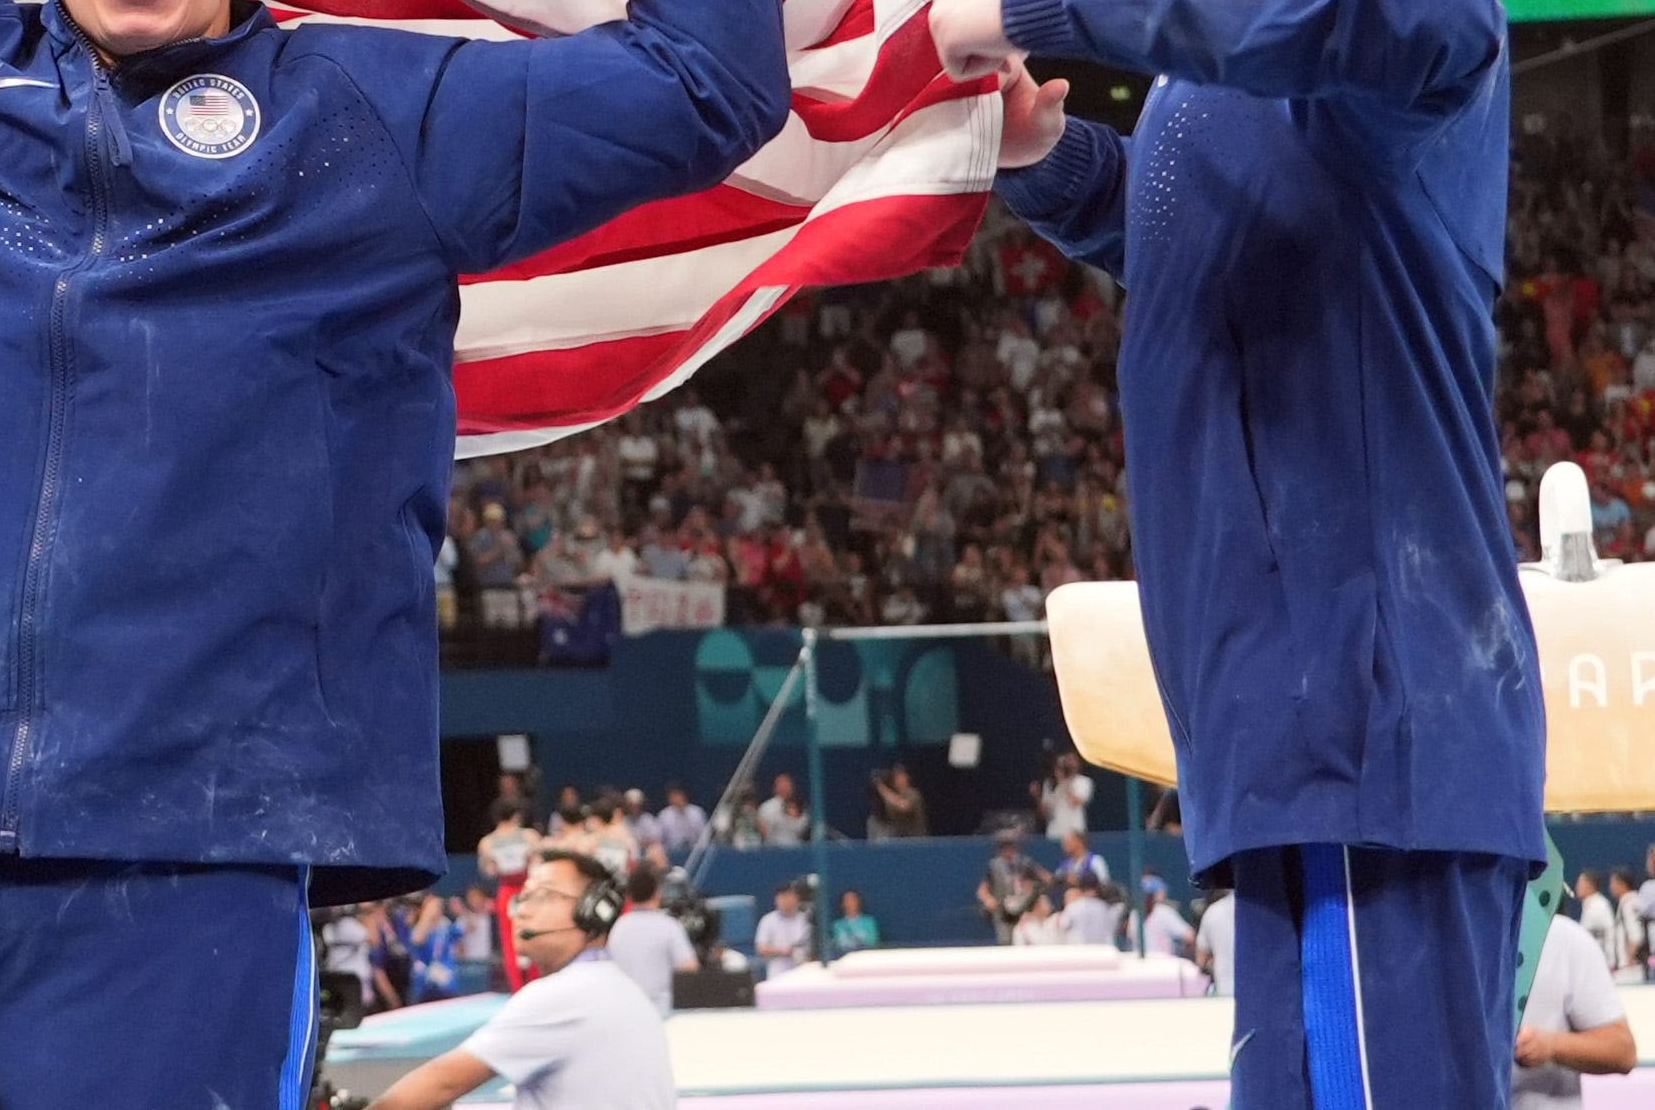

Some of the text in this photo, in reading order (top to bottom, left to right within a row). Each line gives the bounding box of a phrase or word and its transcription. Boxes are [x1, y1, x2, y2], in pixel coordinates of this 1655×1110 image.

[210, 79, 245, 100] STATES
[176, 132, 246, 153] OLYMPIC TEAM
